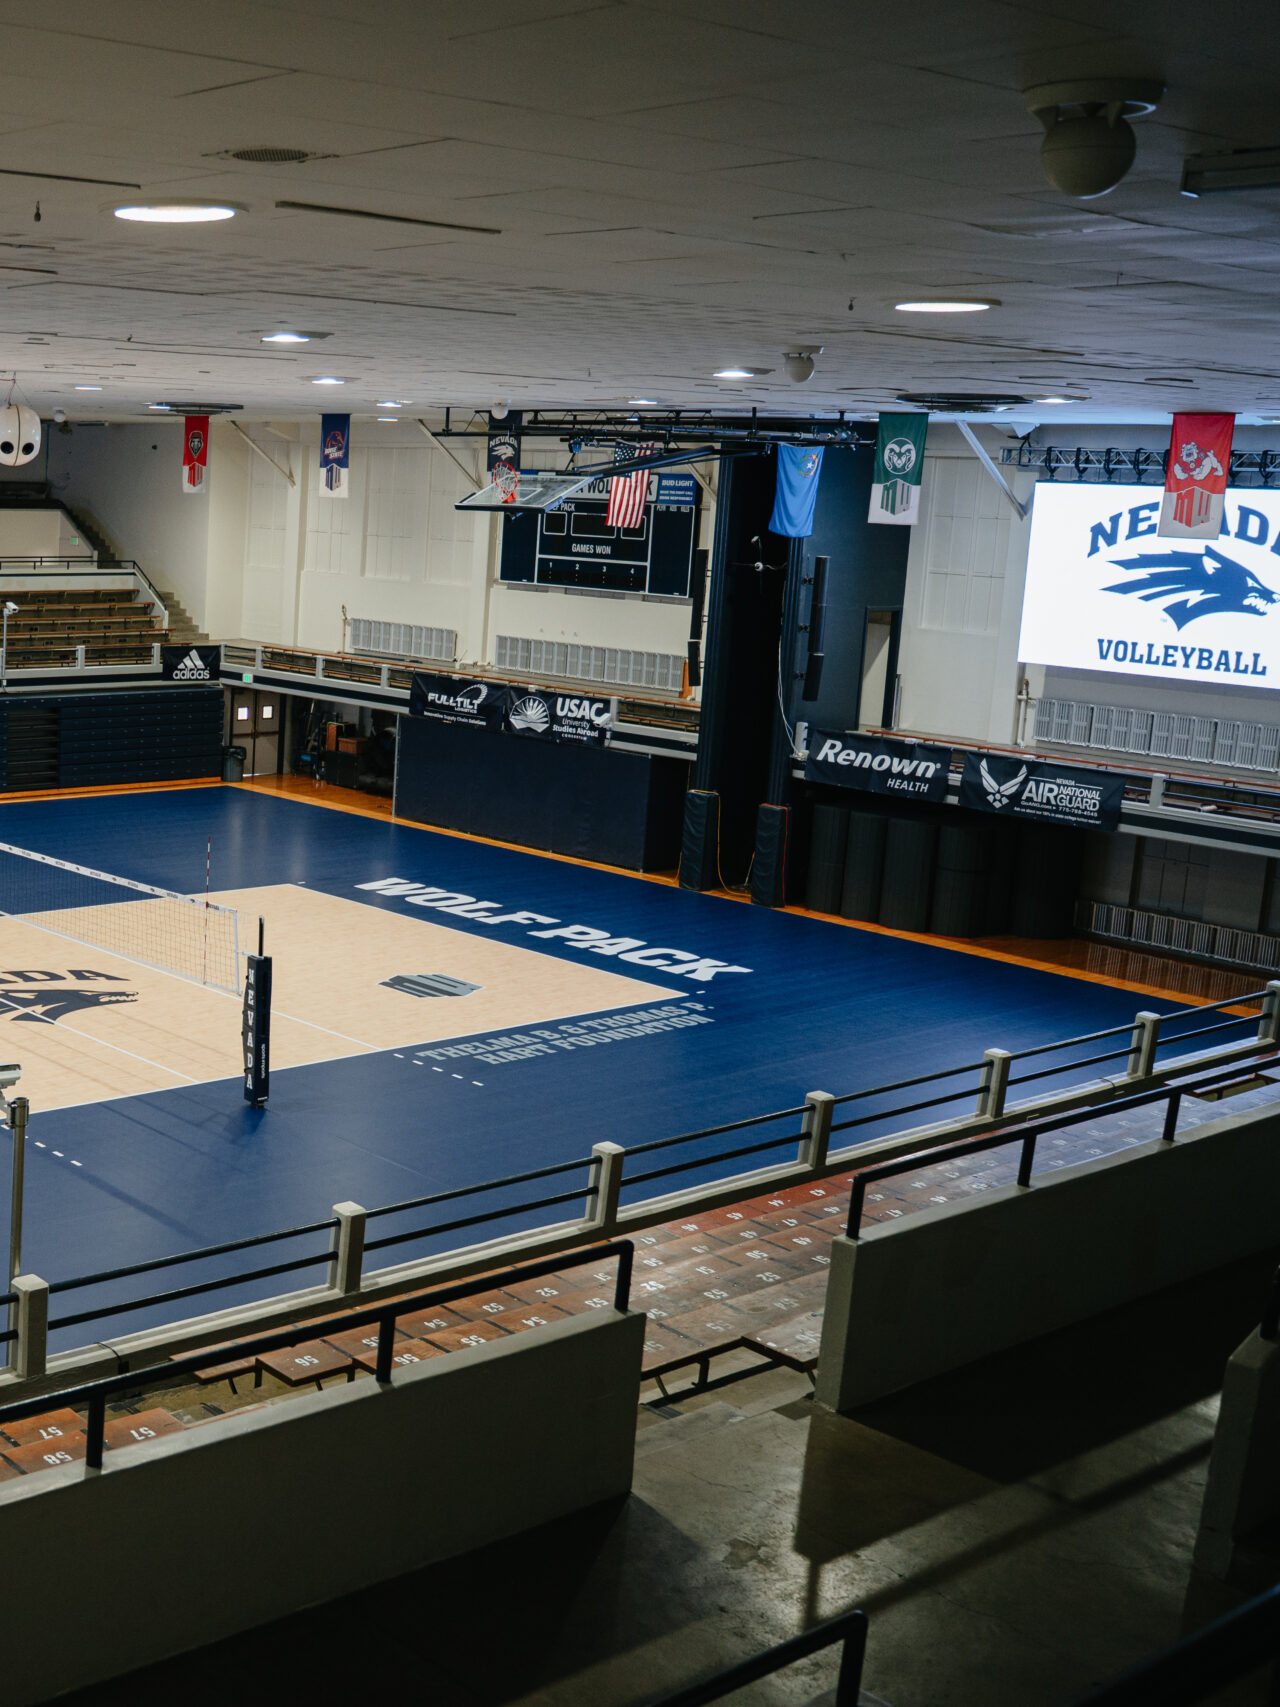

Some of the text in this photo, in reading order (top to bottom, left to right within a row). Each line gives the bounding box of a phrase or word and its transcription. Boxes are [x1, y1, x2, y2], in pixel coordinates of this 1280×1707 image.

[588, 479, 612, 494] WOL
[560, 502, 576, 512] PACK
[571, 543, 612, 555] GAMES WON
[1097, 638, 1267, 677] VOLLEYBALL
[172, 667, 211, 680] adidas
[555, 697, 604, 724] USAC
[552, 724, 599, 737] Studies Abroad
[562, 717, 590, 730] University
[816, 739, 937, 779] Renown
[886, 778, 929, 793] HEALTH
[1021, 780, 1059, 805] AIR
[1058, 785, 1101, 800] NATIONAL
[1056, 794, 1100, 812] GUARD
[353, 877, 754, 982] WOLF PACK
[246, 967, 255, 1090] NEVADA
[416, 1033, 543, 1061] THELMA
[576, 1005, 685, 1030] THOMAS
[679, 1002, 716, 1011] P.
[473, 1013, 717, 1066] HART FOUNDATION
[593, 1272, 612, 1282] 51
[535, 1287, 559, 1297] 52
[482, 1302, 505, 1313] 53
[584, 1297, 609, 1308] 53
[423, 1318, 448, 1329] 54
[521, 1316, 548, 1327] 54
[460, 1335, 487, 1347] 55
[294, 1355, 320, 1367] 56
[393, 1353, 421, 1365] 56
[39, 1426, 64, 1441] 57
[129, 1426, 157, 1441] 57
[42, 1450, 73, 1466] 58
